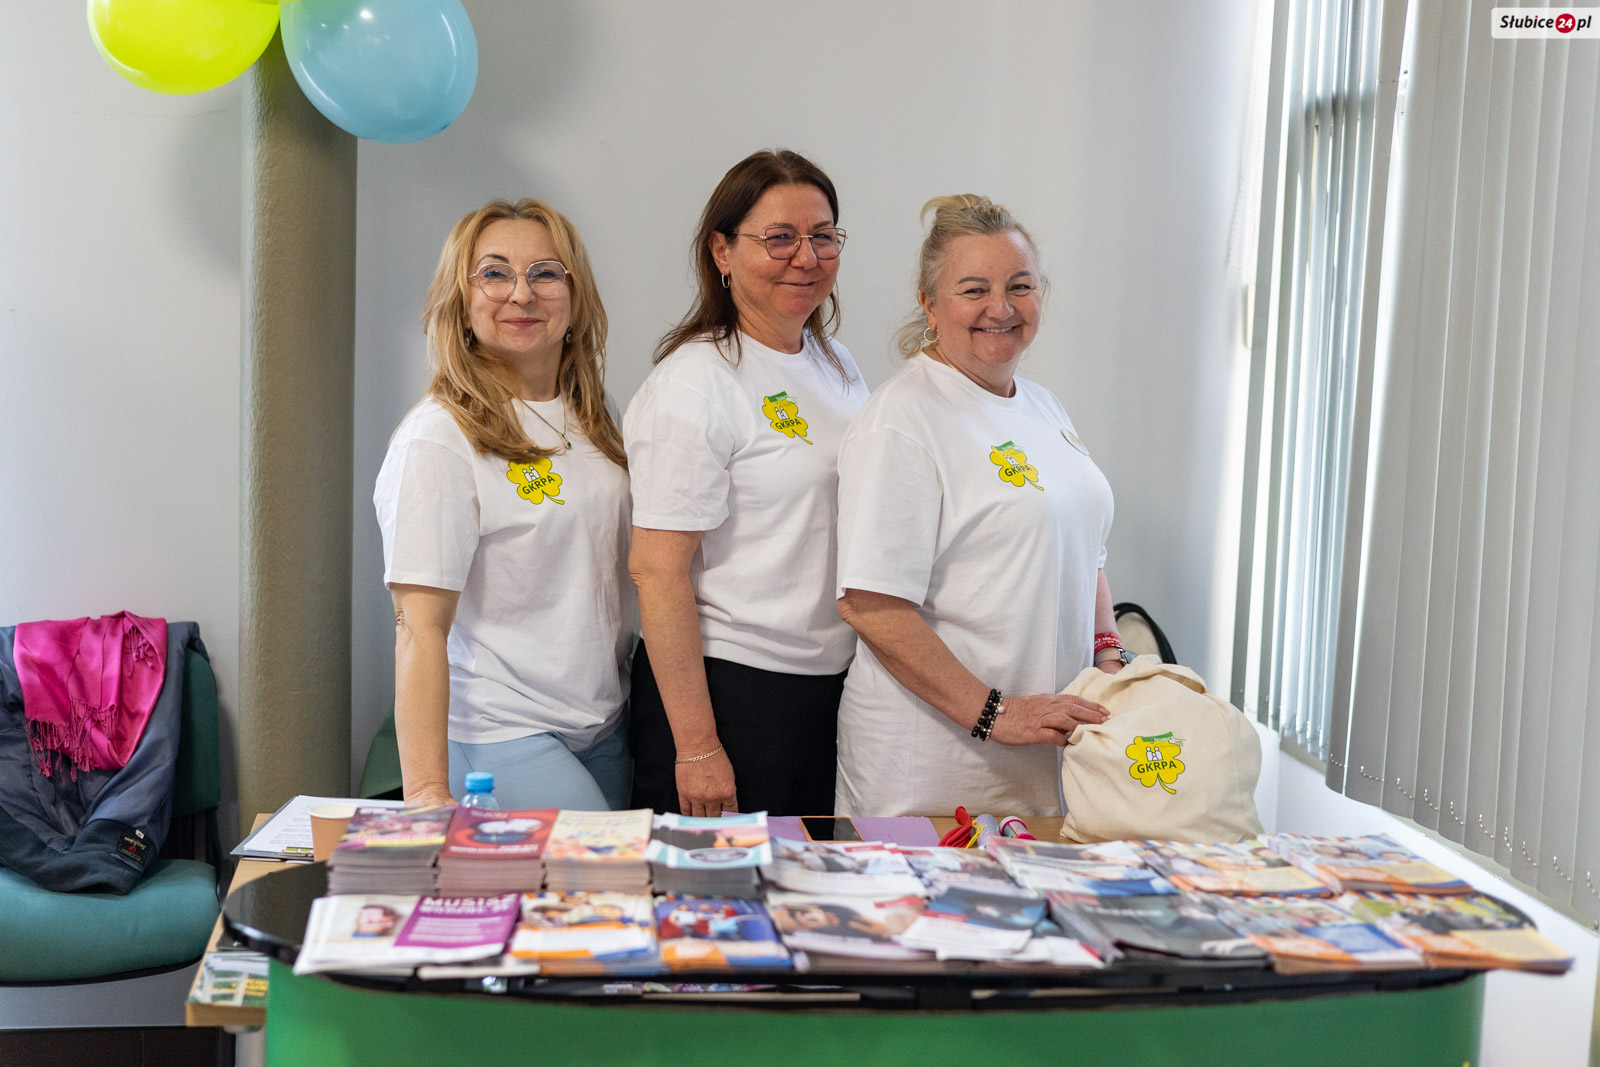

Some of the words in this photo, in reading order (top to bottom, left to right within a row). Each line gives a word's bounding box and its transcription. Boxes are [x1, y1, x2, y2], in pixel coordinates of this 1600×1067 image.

[775, 418, 802, 430] GKRPA
[1004, 464, 1033, 477] GKRPA
[522, 475, 556, 495] GKRPA
[1137, 760, 1177, 774] GKRPA
